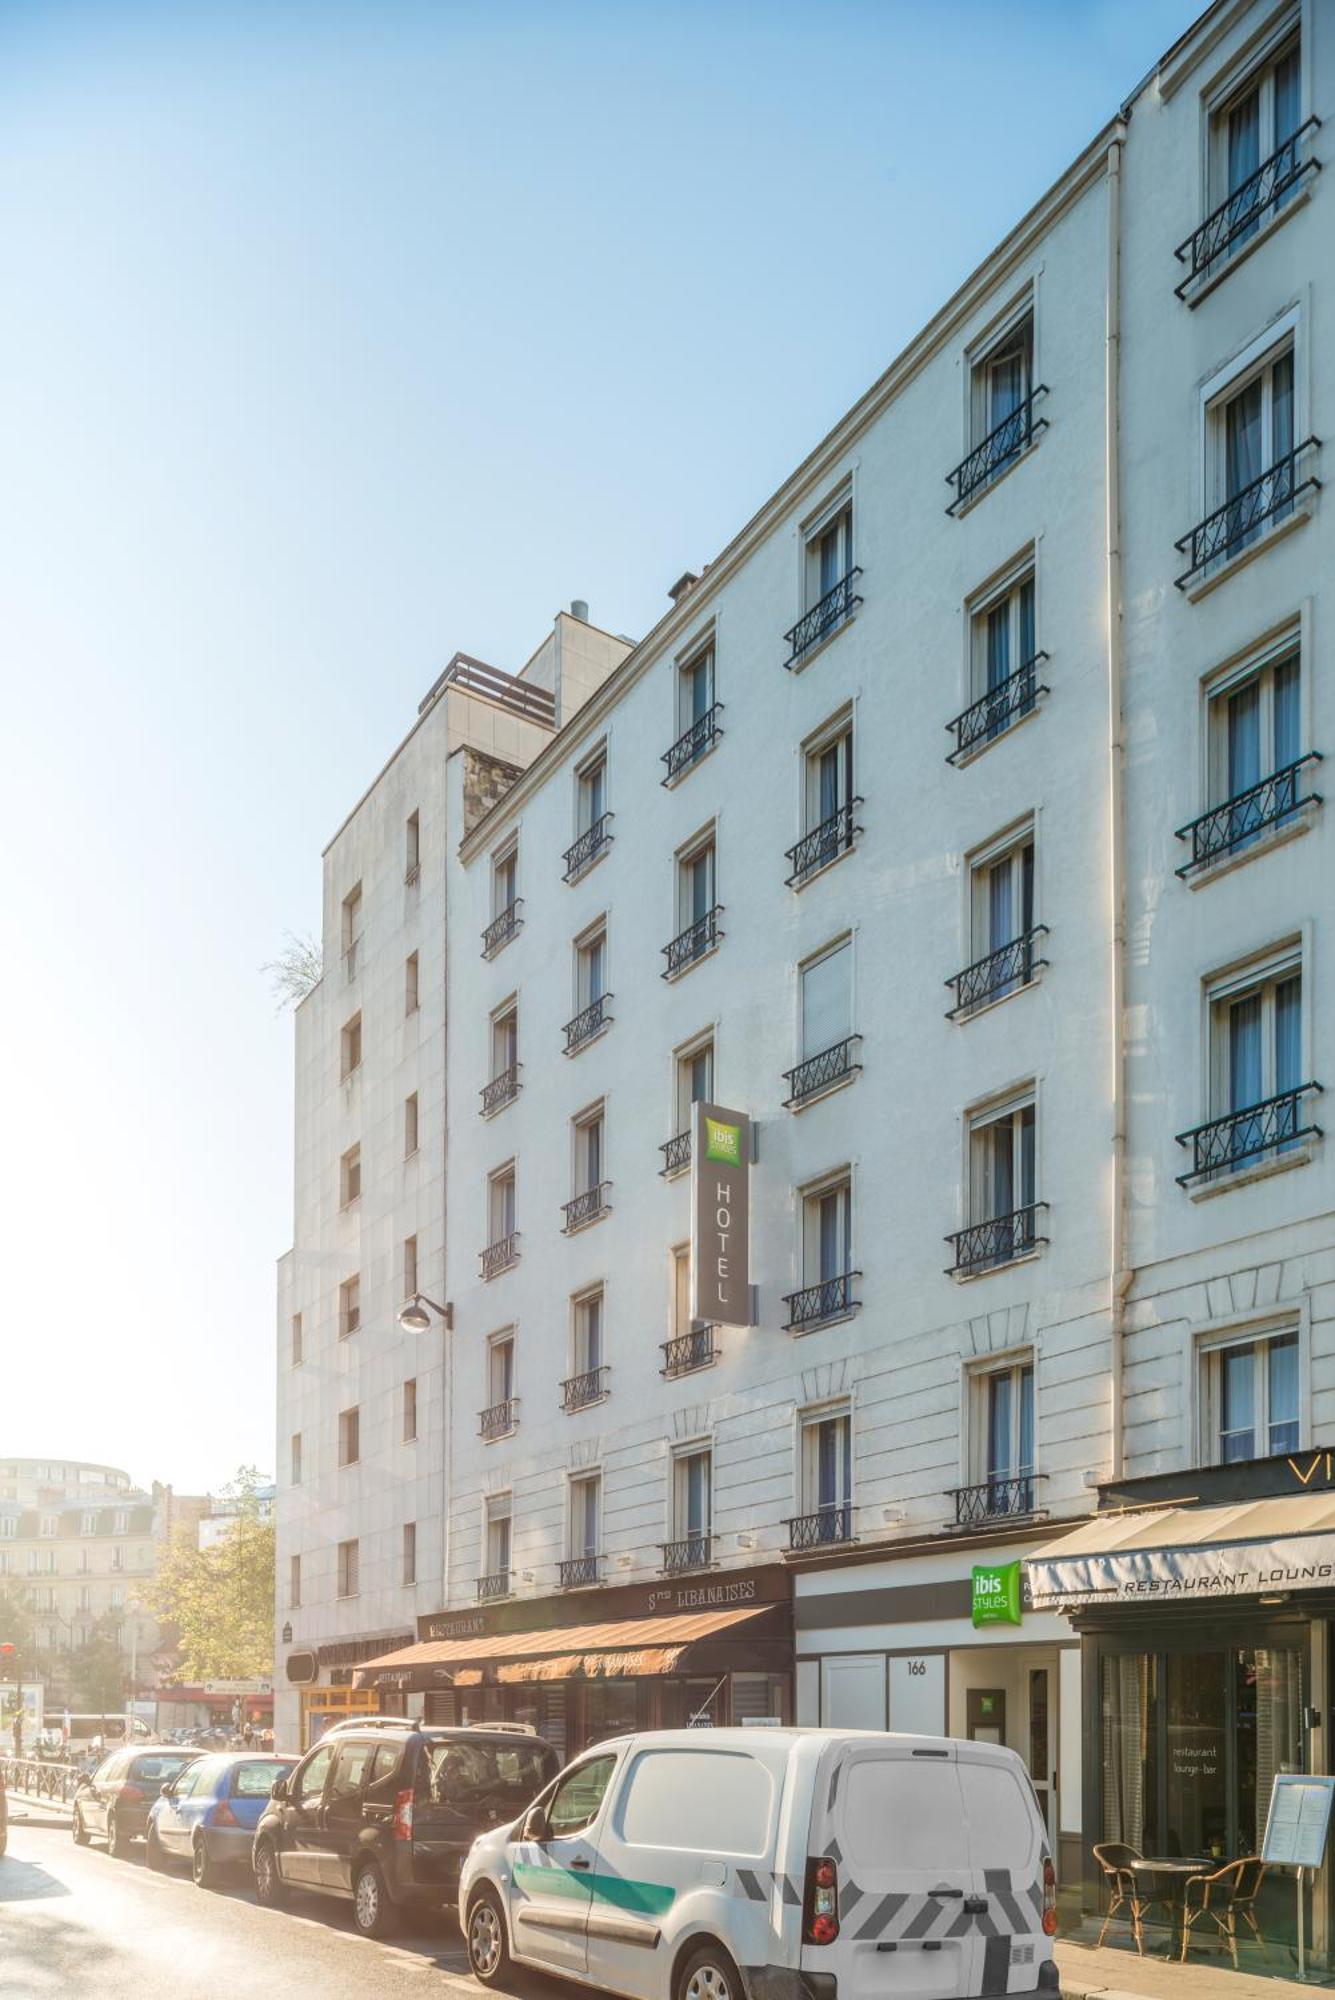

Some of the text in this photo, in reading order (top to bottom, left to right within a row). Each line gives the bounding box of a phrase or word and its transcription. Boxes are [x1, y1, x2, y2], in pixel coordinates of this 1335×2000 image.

[714, 1128, 734, 1145] ibis
[717, 1182, 731, 1302] HOTEL
[975, 1574, 1002, 1595] ibis
[1124, 1572, 1249, 1593] RESTAURANT
[678, 1580, 755, 1608] LIBANAISES
[973, 1595, 1008, 1611] STYLES
[907, 1661, 926, 1676] 166
[1173, 1746, 1217, 1758] restaurant
